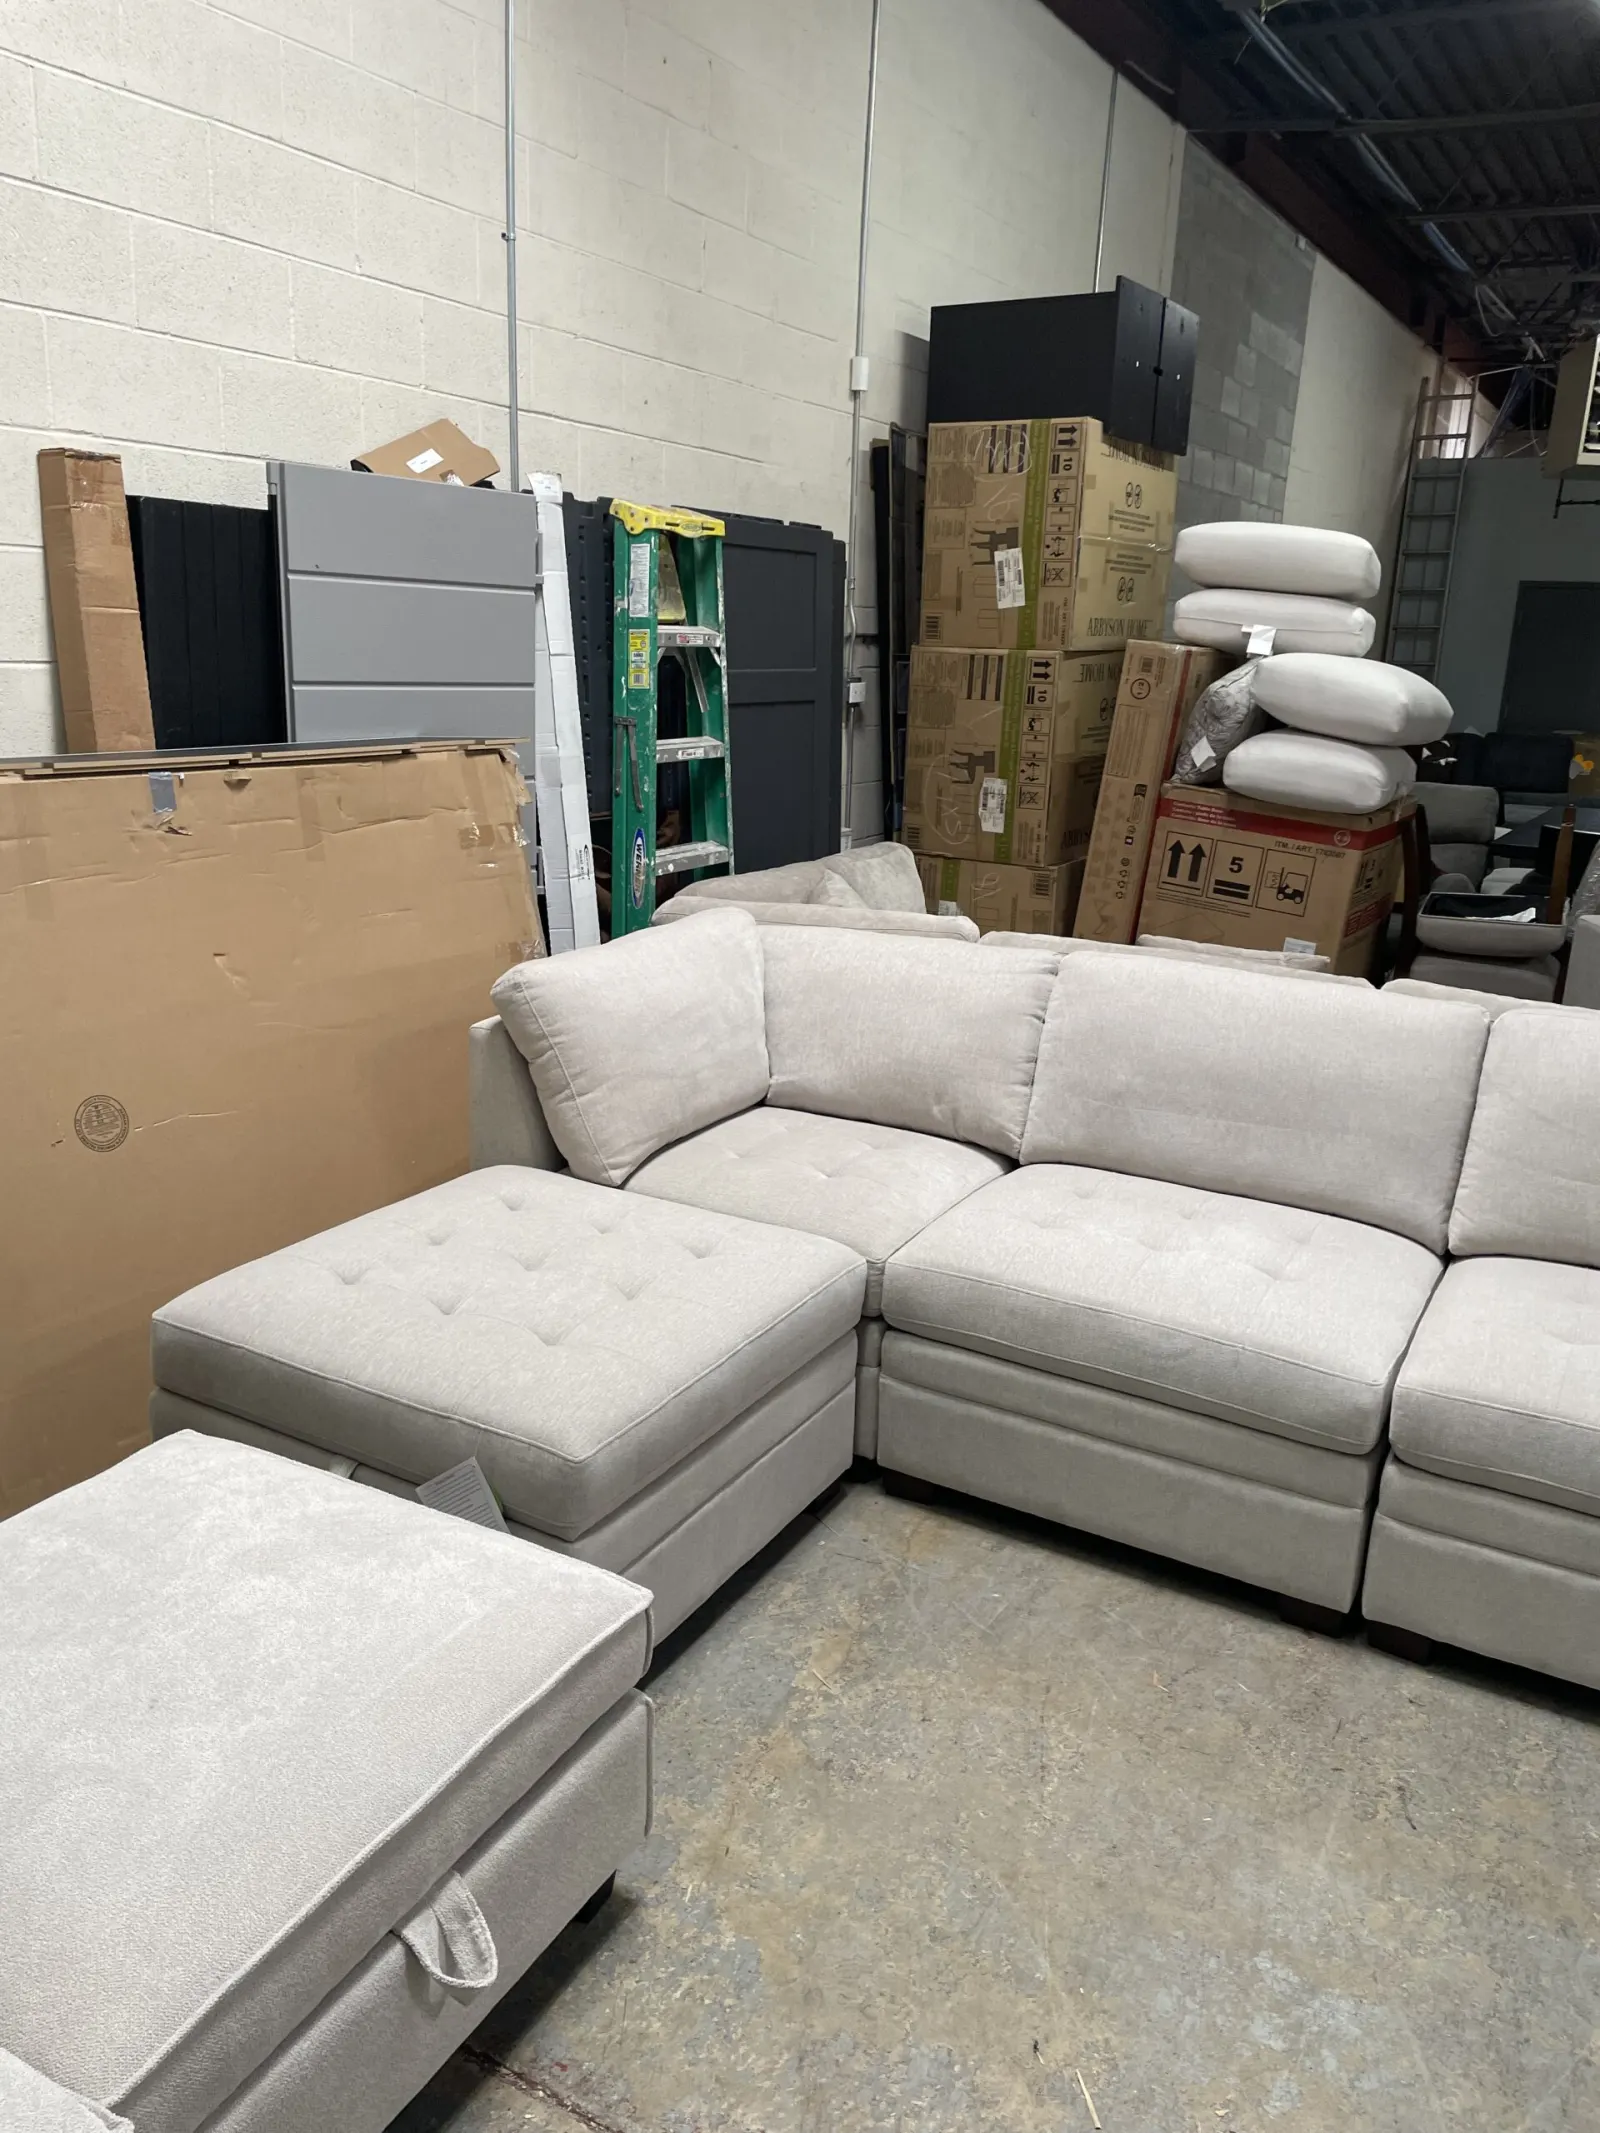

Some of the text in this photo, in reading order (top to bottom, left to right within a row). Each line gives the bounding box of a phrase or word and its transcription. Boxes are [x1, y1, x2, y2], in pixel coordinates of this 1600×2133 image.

[1063, 457, 1073, 471] 10
[1086, 617, 1125, 637] ABBYSON
[1127, 618, 1153, 638] HOME
[1072, 664, 1105, 682] HOME
[1037, 689, 1047, 703] 10
[1228, 856, 1244, 873] 5
